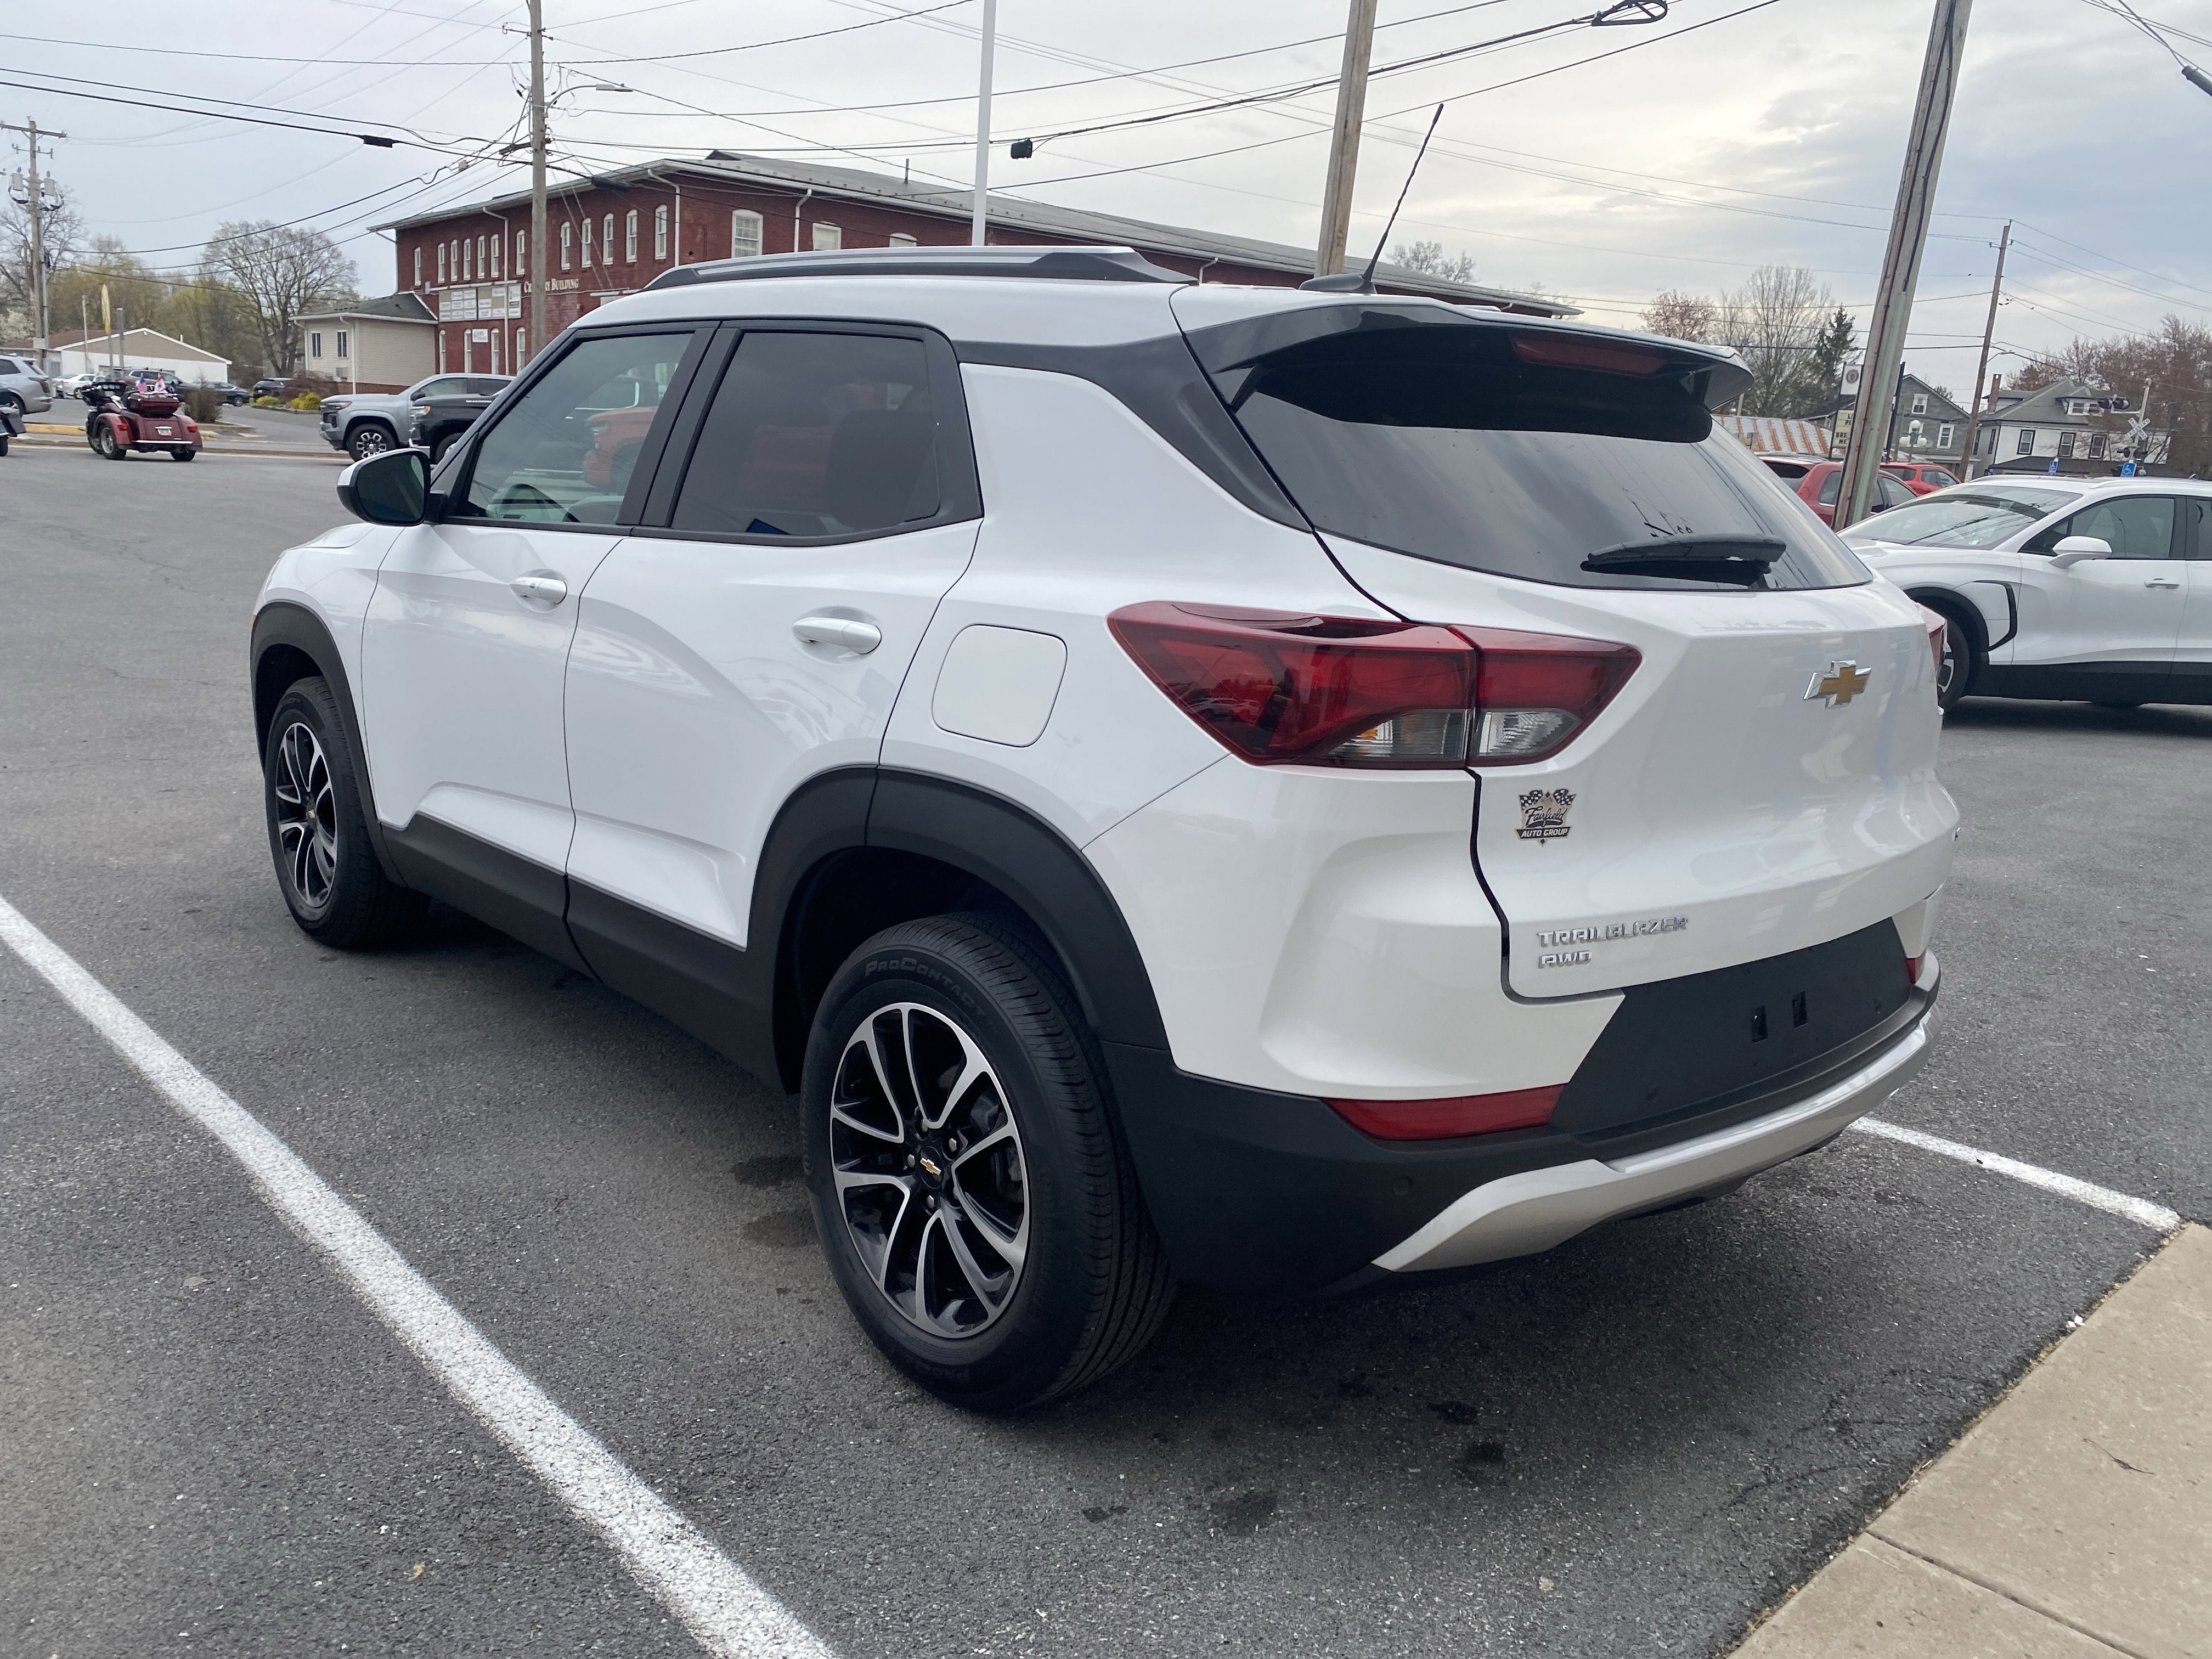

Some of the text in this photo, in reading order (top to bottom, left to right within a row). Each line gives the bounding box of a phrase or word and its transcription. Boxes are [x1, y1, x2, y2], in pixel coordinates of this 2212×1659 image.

[1525, 806, 1567, 827] Fairfield
[1537, 915, 1688, 947] TRAILBLAZER
[1538, 950, 1592, 969] AWD
